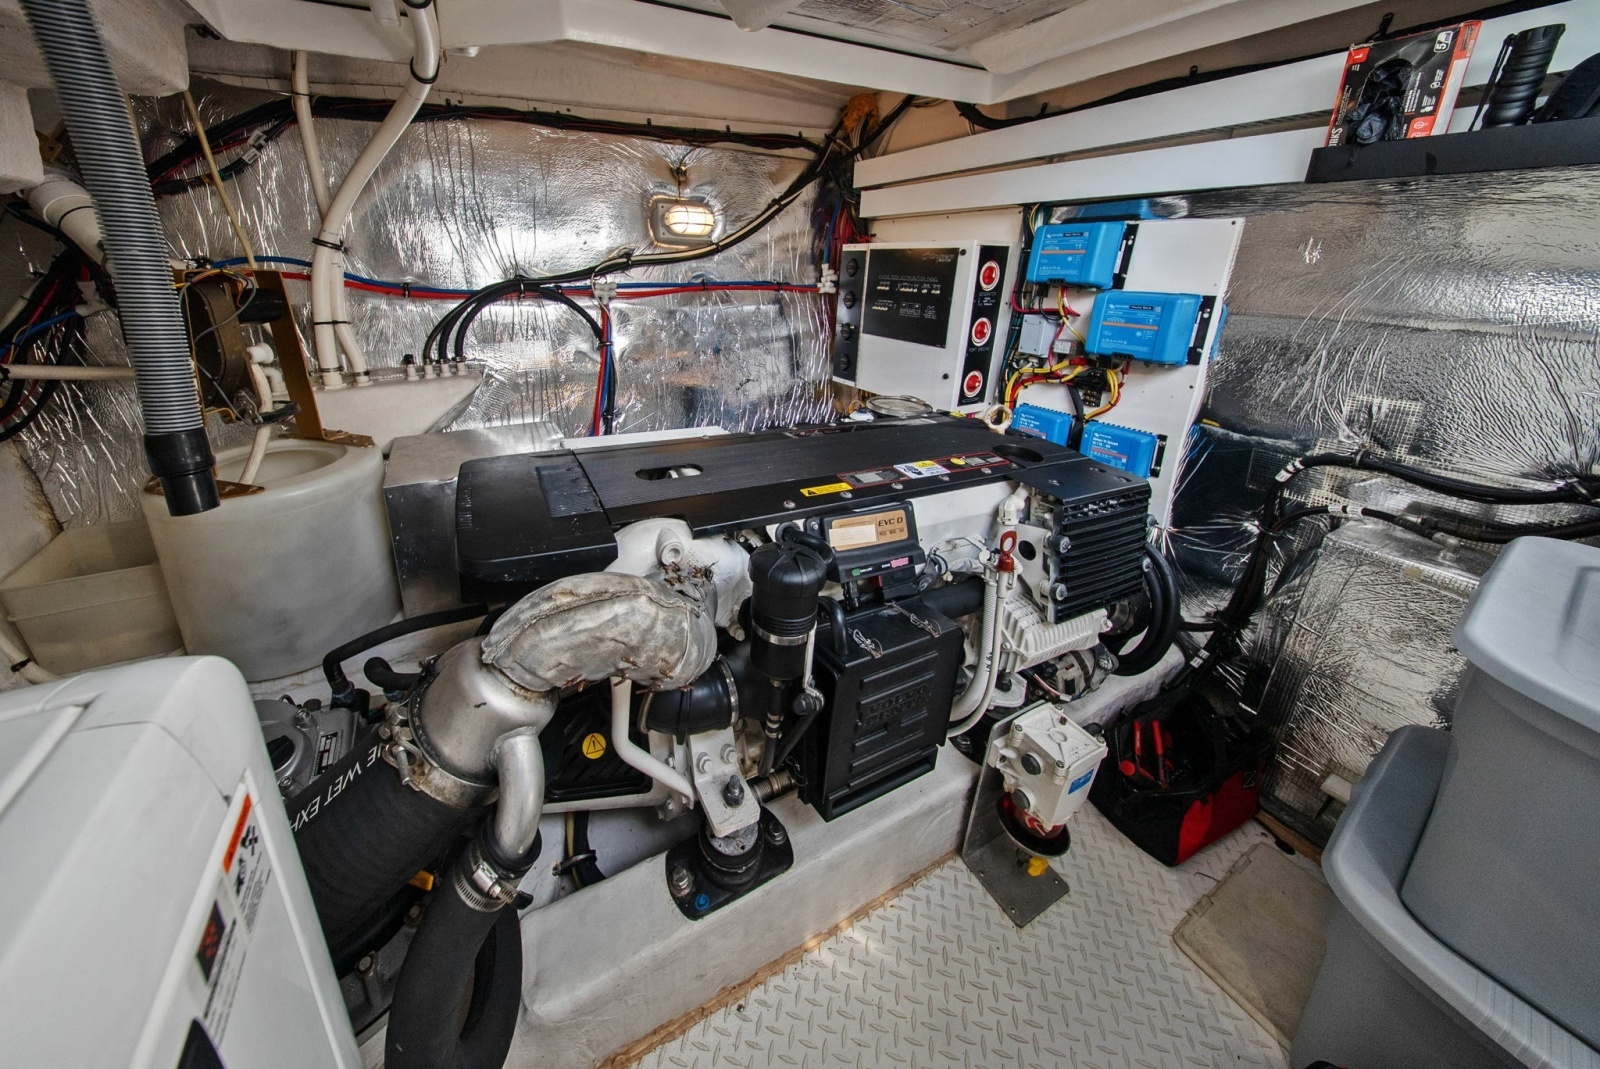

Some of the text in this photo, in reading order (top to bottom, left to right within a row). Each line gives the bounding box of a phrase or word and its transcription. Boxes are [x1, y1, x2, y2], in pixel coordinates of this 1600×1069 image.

[1435, 38, 1446, 50] 5
[878, 519, 894, 527] EVC
[323, 761, 362, 806] WET
